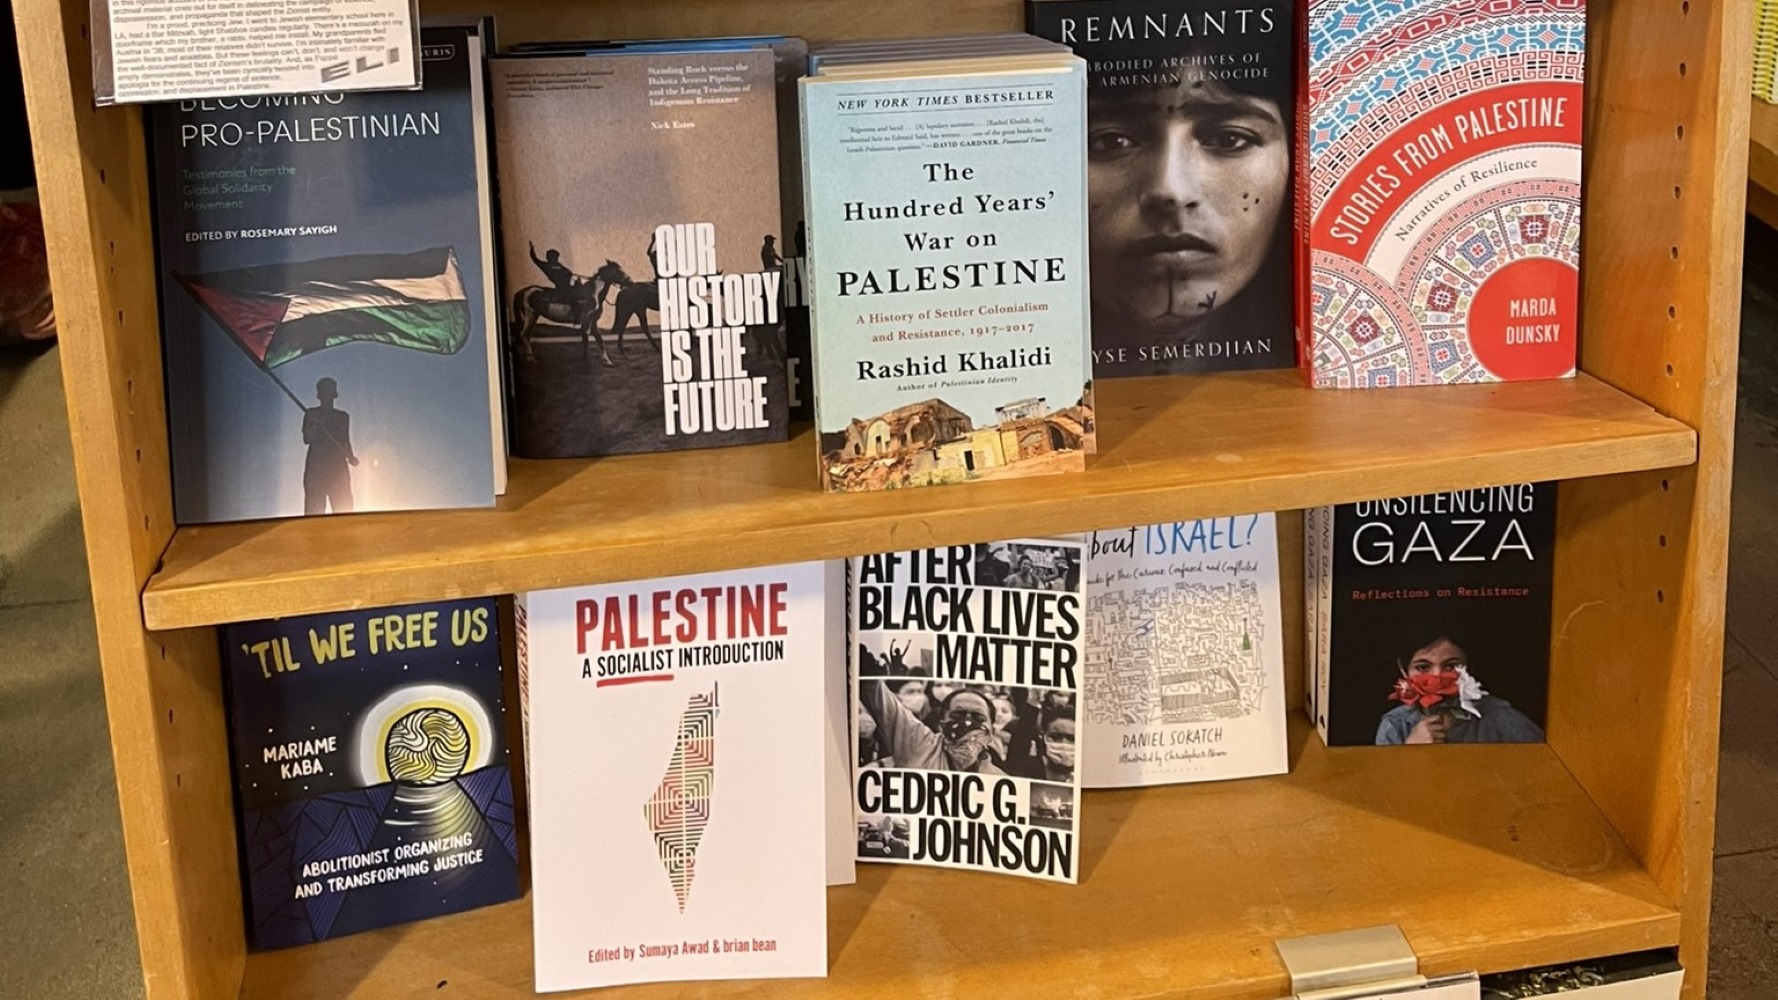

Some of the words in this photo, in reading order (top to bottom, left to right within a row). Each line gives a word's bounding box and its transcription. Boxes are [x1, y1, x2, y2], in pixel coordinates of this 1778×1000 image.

[1061, 8, 1275, 44] REMNANTS
[320, 47, 399, 83] ELI
[647, 66, 684, 76] Standing
[685, 65, 706, 74] Rock
[735, 63, 749, 72] the
[1161, 53, 1235, 68] ARCHIVES
[1242, 53, 1262, 64] OF
[648, 77, 678, 86] Dakota
[649, 88, 664, 96] and
[665, 87, 679, 96] the
[680, 87, 701, 97] Long
[703, 86, 741, 95] Tradition
[742, 84, 751, 93] of
[1101, 72, 1180, 87] ARMENIAN
[1188, 67, 1269, 82] GENOCIDE
[650, 98, 694, 108] Indigenous
[696, 97, 739, 106] Resistance
[837, 100, 868, 111] NEW
[874, 97, 910, 109] YORK
[916, 95, 959, 107] TIMES
[965, 90, 1054, 104] BESTSELLER
[182, 112, 440, 147] PRO-PALESTINIAN
[651, 121, 670, 130] Nick
[672, 120, 695, 129] Estes
[183, 167, 248, 182] Testimonies
[250, 165, 276, 180] from
[277, 164, 296, 176] the
[923, 163, 974, 182] The
[1330, 165, 1401, 245] STORIES
[1393, 124, 1454, 176] FROM
[1455, 97, 1568, 144] PALESTINE
[183, 182, 220, 196] Global
[221, 181, 273, 196] Solidarity
[1395, 190, 1451, 242] Narratives
[1453, 175, 1467, 192] of
[1470, 158, 1538, 183] Resilience
[184, 198, 243, 212] Movement
[843, 196, 964, 221] Hundred
[185, 231, 223, 242] EDITED
[224, 230, 238, 240] BY
[240, 227, 297, 239] ROSEMARY
[299, 224, 338, 236] SAYIGH
[904, 232, 954, 251] War
[966, 233, 997, 248] on
[655, 222, 717, 278] OUR
[837, 257, 1066, 296] PALESTINE
[658, 271, 780, 331] HISTORY
[856, 314, 865, 324] A
[869, 312, 914, 325] History
[918, 309, 930, 319] of
[934, 307, 974, 319] Settler
[978, 302, 1049, 315] Colonialism
[1510, 297, 1556, 318] MARDA
[872, 332, 894, 343] and
[898, 328, 965, 341] Resistance,
[1506, 323, 1560, 345] DUNSKY
[661, 330, 693, 383] IS
[696, 326, 748, 381] THE
[857, 355, 947, 380] Rashid
[958, 347, 1052, 372] Khalidi
[1139, 338, 1271, 362] SEMERDJIAN
[897, 383, 926, 392] Author
[928, 381, 937, 390] of
[941, 379, 985, 388] Palestinian
[987, 376, 1018, 386] Identity
[663, 376, 770, 436] FUTURE
[1146, 514, 1258, 555] ISRAEL?
[1352, 518, 1535, 566] GAZA
[860, 543, 972, 585] AFTER
[1353, 589, 1429, 600] Reflections
[1437, 588, 1451, 597] on
[1458, 586, 1530, 597] Resistance
[576, 582, 788, 655] PALESTINE
[859, 585, 975, 634] BLACK
[983, 589, 1080, 642] LIVES
[309, 622, 356, 665] WE
[368, 611, 439, 655] FREE
[451, 606, 489, 647] US
[582, 657, 592, 679] A
[597, 649, 673, 677] SOCIALIST
[678, 640, 784, 668] INTRODUCTION
[936, 634, 1077, 689] MATTER
[263, 736, 337, 764] MARIAME
[1122, 732, 1165, 748] DANIEL
[1170, 728, 1223, 746] SOKATCH
[280, 759, 324, 780] KABA
[858, 770, 985, 819] CEDRIC
[993, 778, 1026, 825] G.
[302, 848, 390, 878] ABOLITIONIST
[394, 832, 473, 862] ORGANIZING
[913, 817, 1072, 879] JOHNSON
[295, 882, 324, 899] AND
[327, 860, 429, 892] TRANSFORMING
[434, 849, 484, 873] JUSTICE
[588, 947, 620, 964] Edited
[623, 945, 636, 962] by
[639, 943, 679, 959] Sumaya
[682, 940, 709, 955] Awad
[712, 939, 721, 953] &
[723, 939, 749, 953] brian
[752, 937, 776, 951] bean
